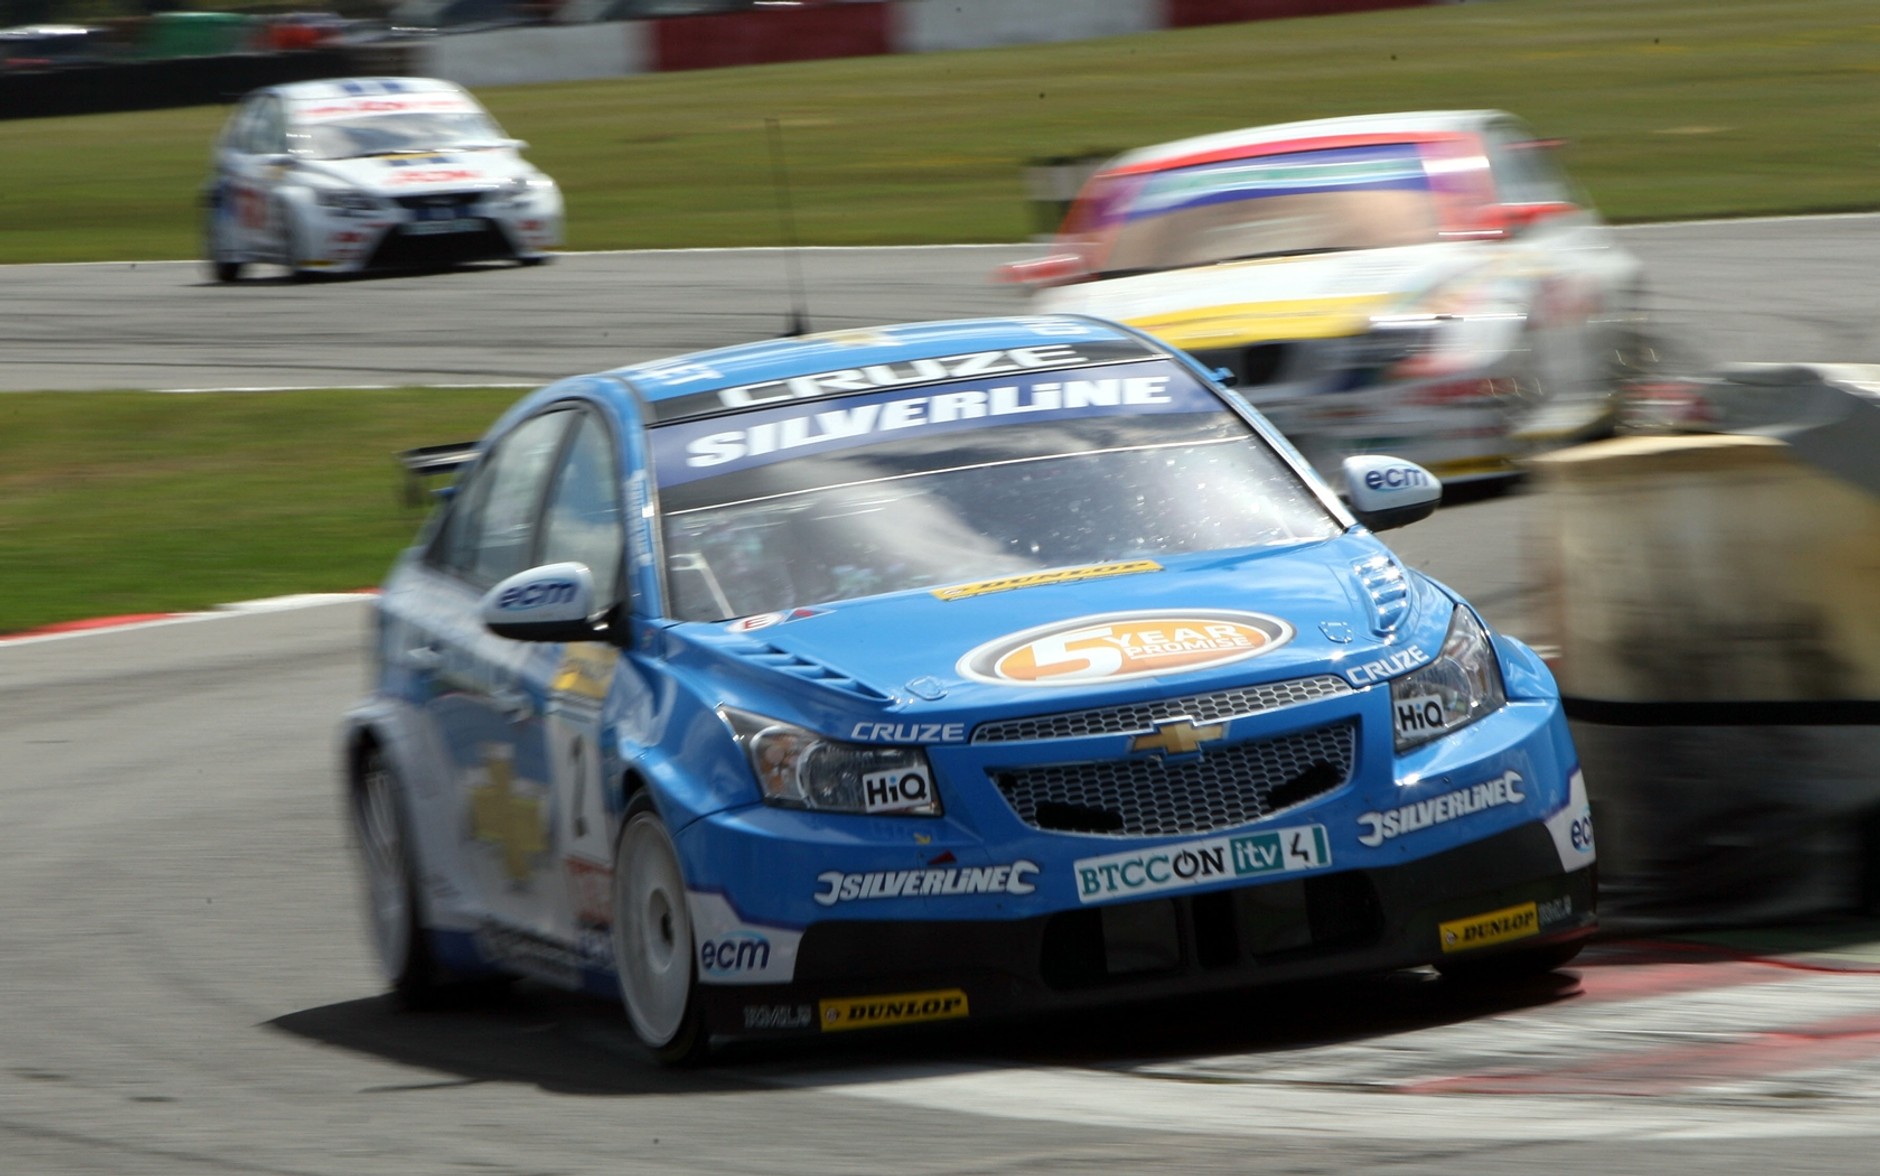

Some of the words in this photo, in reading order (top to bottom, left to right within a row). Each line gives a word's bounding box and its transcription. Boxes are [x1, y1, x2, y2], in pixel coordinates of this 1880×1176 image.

[718, 345, 1088, 408] CRUZE
[1365, 468, 1428, 490] ecm
[496, 583, 578, 609] ecm
[1031, 627, 1123, 680] 5
[1101, 624, 1241, 650] YEAR
[1127, 635, 1252, 660] PROMISE
[1346, 645, 1430, 684] CRUZE
[1398, 701, 1444, 731] HiQ
[851, 722, 965, 742] CRUZE
[866, 773, 927, 806] HiQ
[1236, 841, 1278, 871] itv
[1290, 833, 1310, 862] 4
[1463, 911, 1535, 942] DUNLOP
[702, 936, 771, 971] ecm
[848, 997, 963, 1022] DUNLOP
